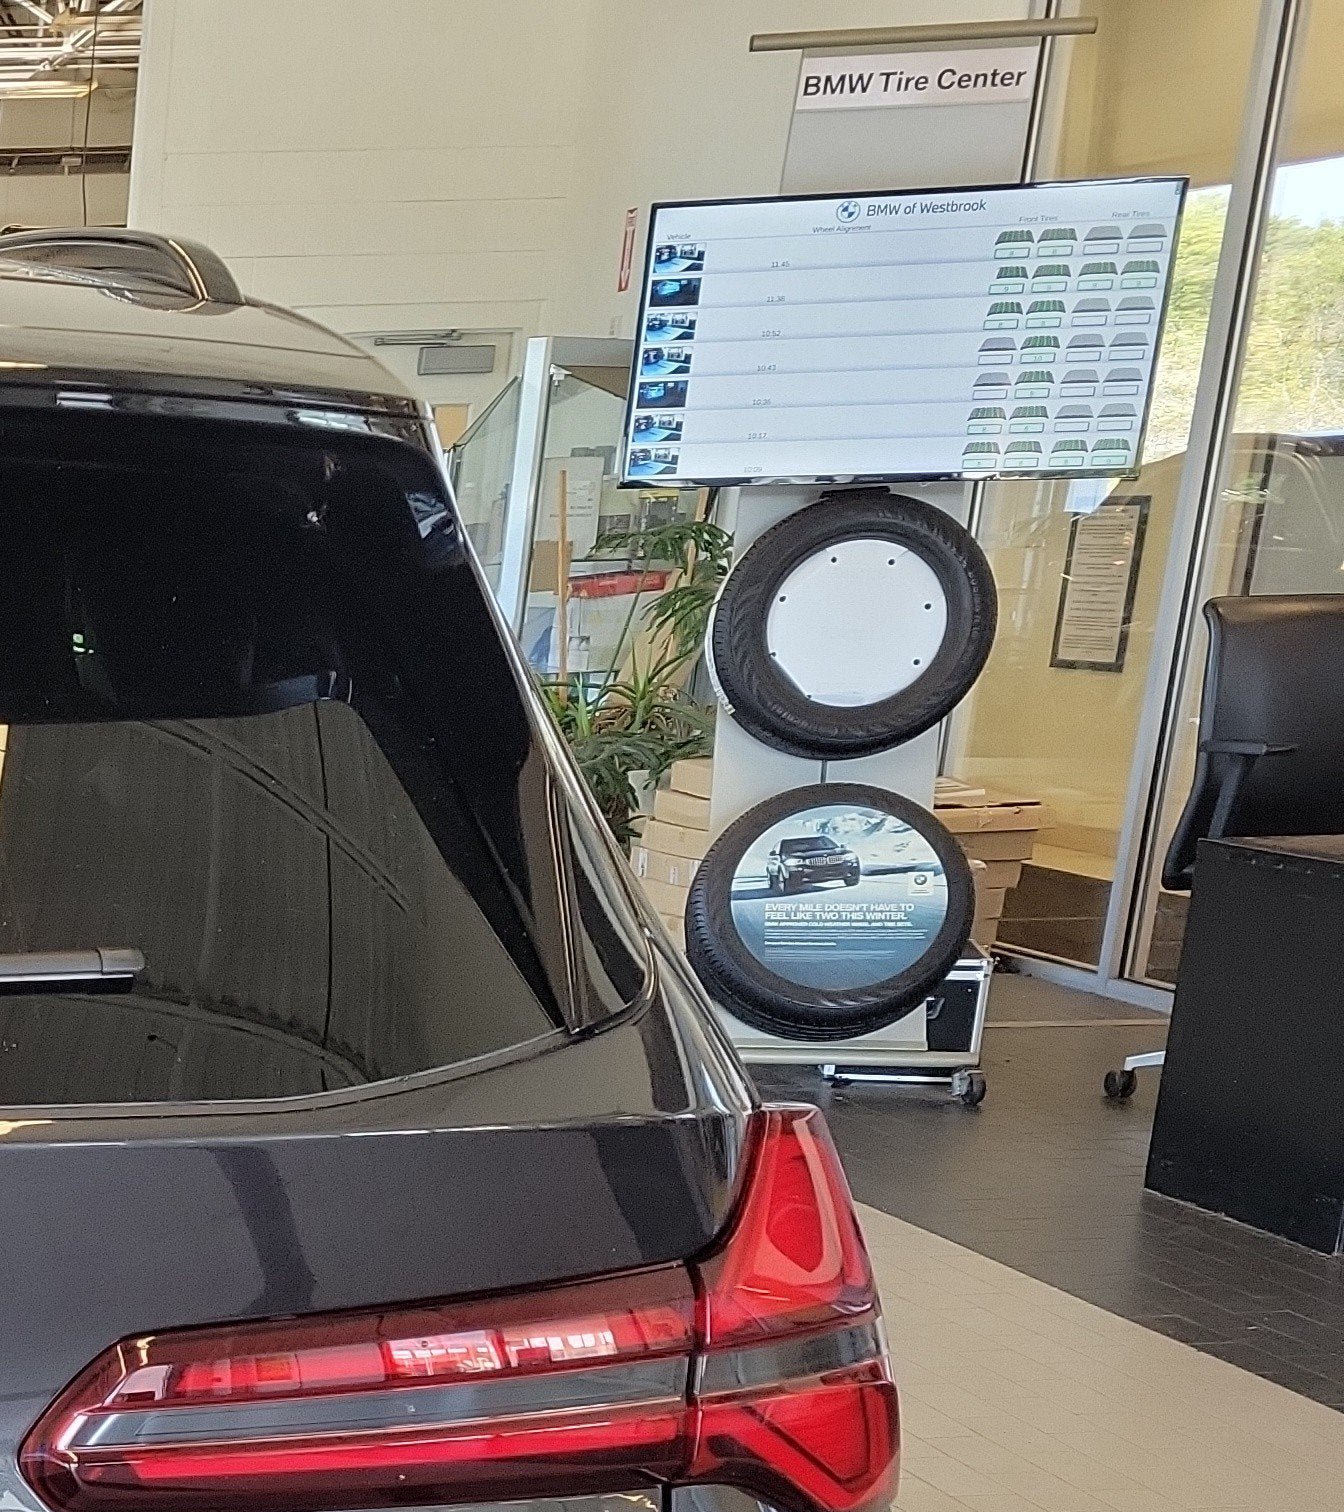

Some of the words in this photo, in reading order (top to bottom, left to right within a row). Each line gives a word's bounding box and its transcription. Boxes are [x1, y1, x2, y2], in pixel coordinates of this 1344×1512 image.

[803, 73, 874, 96] BMW
[879, 71, 929, 93] Tire
[937, 68, 1027, 90] Center
[866, 203, 902, 217] BMW
[904, 203, 917, 215] of
[920, 199, 987, 214] Westbrook
[812, 226, 835, 234] Wheel
[765, 903, 797, 911] EVERY
[799, 903, 823, 911] MILE
[825, 903, 869, 911] DOESN'T
[870, 903, 899, 911] HAVE
[900, 903, 915, 911] TO
[765, 911, 790, 920] FEEL
[790, 911, 813, 920] LIKE
[814, 911, 839, 920] TWO
[841, 911, 864, 920] THIS
[865, 911, 909, 920] WINTER.
